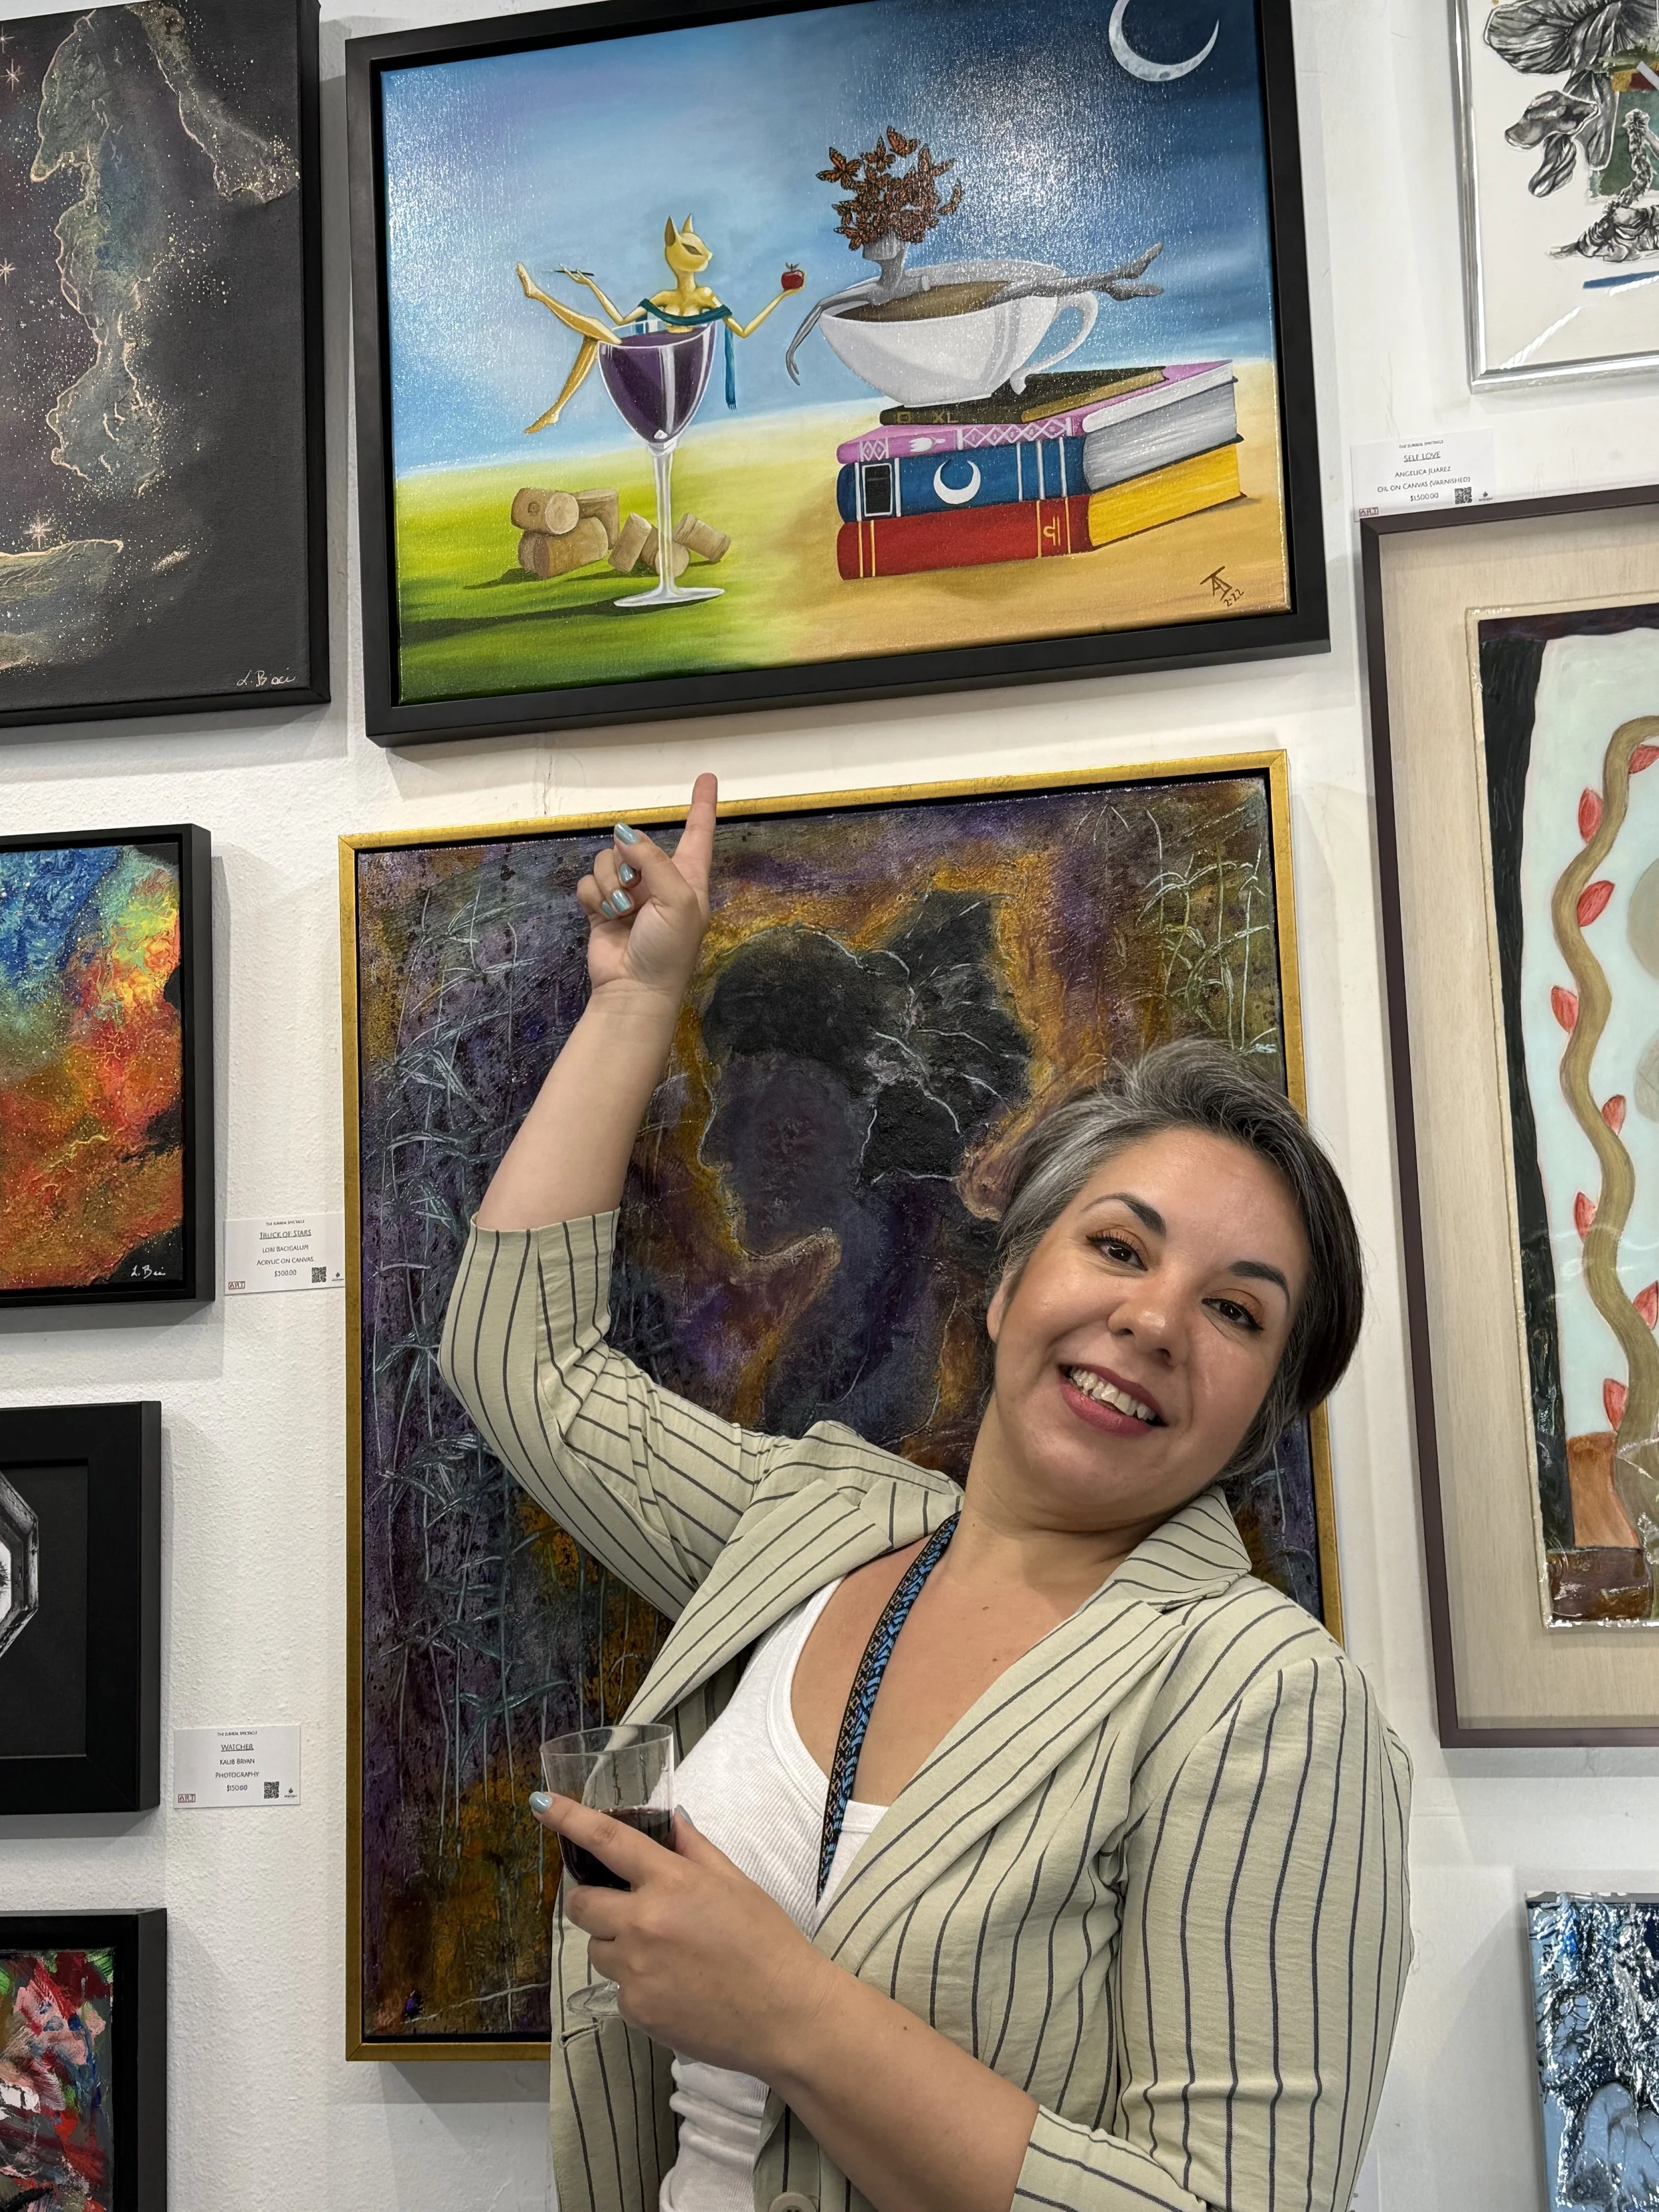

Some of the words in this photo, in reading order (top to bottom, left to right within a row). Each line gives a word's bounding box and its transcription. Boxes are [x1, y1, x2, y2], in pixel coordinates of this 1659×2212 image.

[1404, 454, 1419, 463] SELF
[1421, 451, 1441, 461] LOVE
[1428, 466, 1451, 476] JUAREZ
[1402, 480, 1429, 490] CANVAS
[259, 1231, 282, 1240] TRUCK
[282, 1230, 292, 1239] OF
[293, 1229, 312, 1238] STARS
[220, 1743, 254, 1753] WATCHER
[215, 1771, 260, 1779] PHOTOGRAPHY
